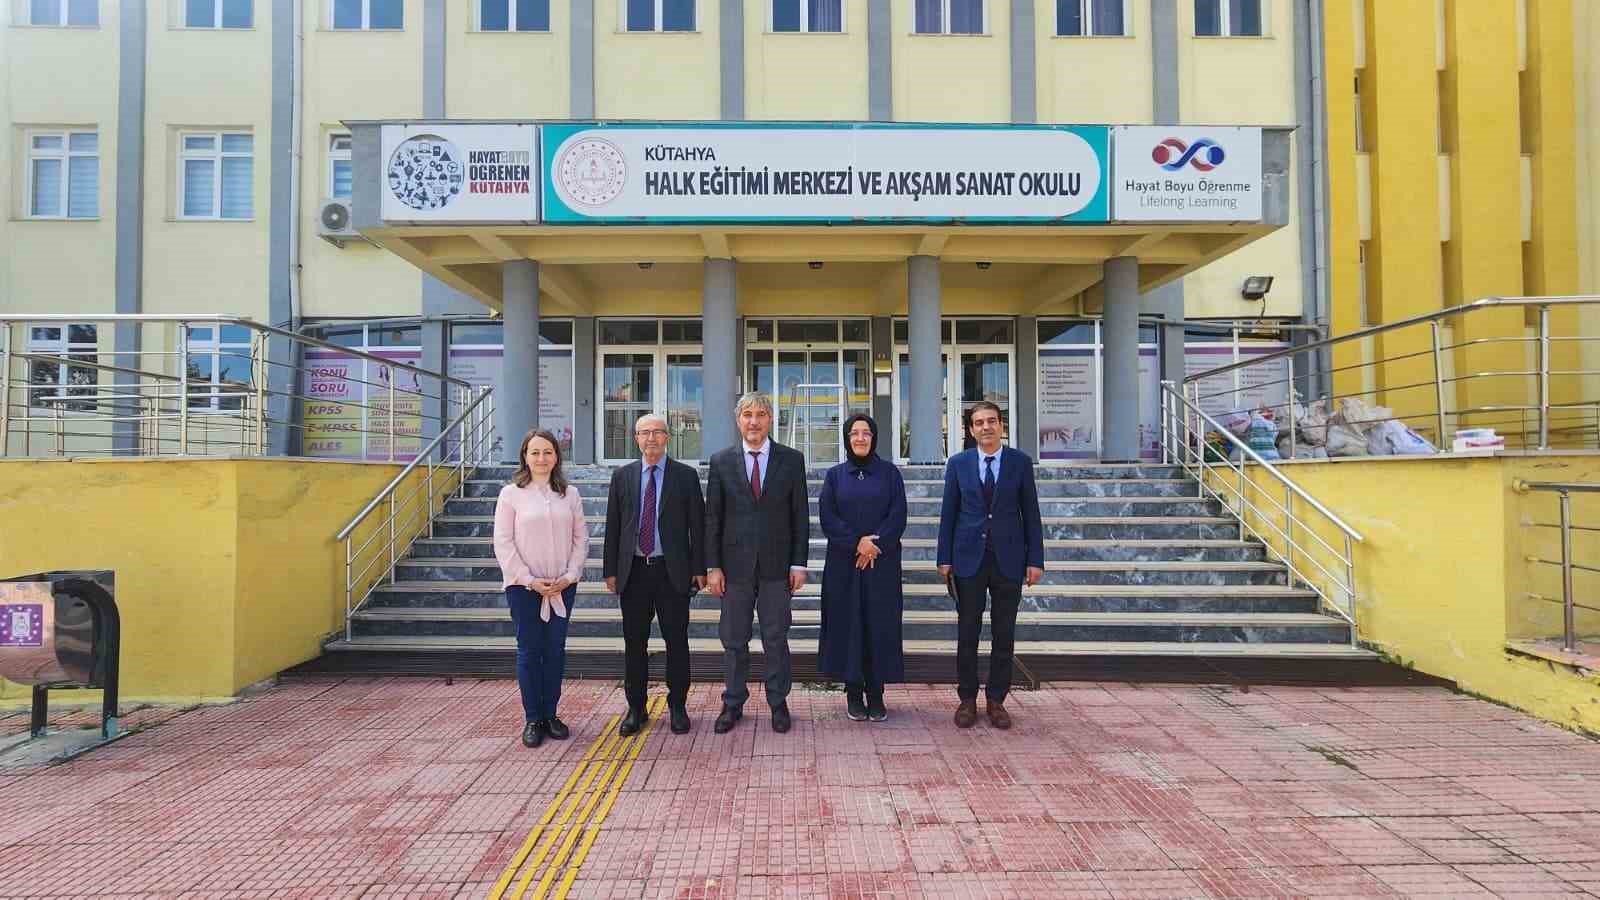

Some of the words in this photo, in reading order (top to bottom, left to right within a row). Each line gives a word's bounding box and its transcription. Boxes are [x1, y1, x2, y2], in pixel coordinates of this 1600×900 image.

[645, 144, 716, 161] KÜTAHYA
[645, 171, 696, 195] HALK
[699, 165, 769, 196] EĞİTİMİ
[773, 165, 852, 196] MERKEZİ
[858, 171, 882, 195] VE
[886, 171, 951, 201] AKŞAM
[955, 171, 1015, 196] SANAT
[1018, 172, 1081, 196] OKULU
[1125, 180, 1161, 193] Hayat
[1164, 180, 1194, 193] Boyu
[1198, 177, 1251, 193] Öğrenme
[1139, 196, 1185, 209] Lifelong
[1188, 196, 1238, 209] Learning
[307, 405, 343, 415] KPSS
